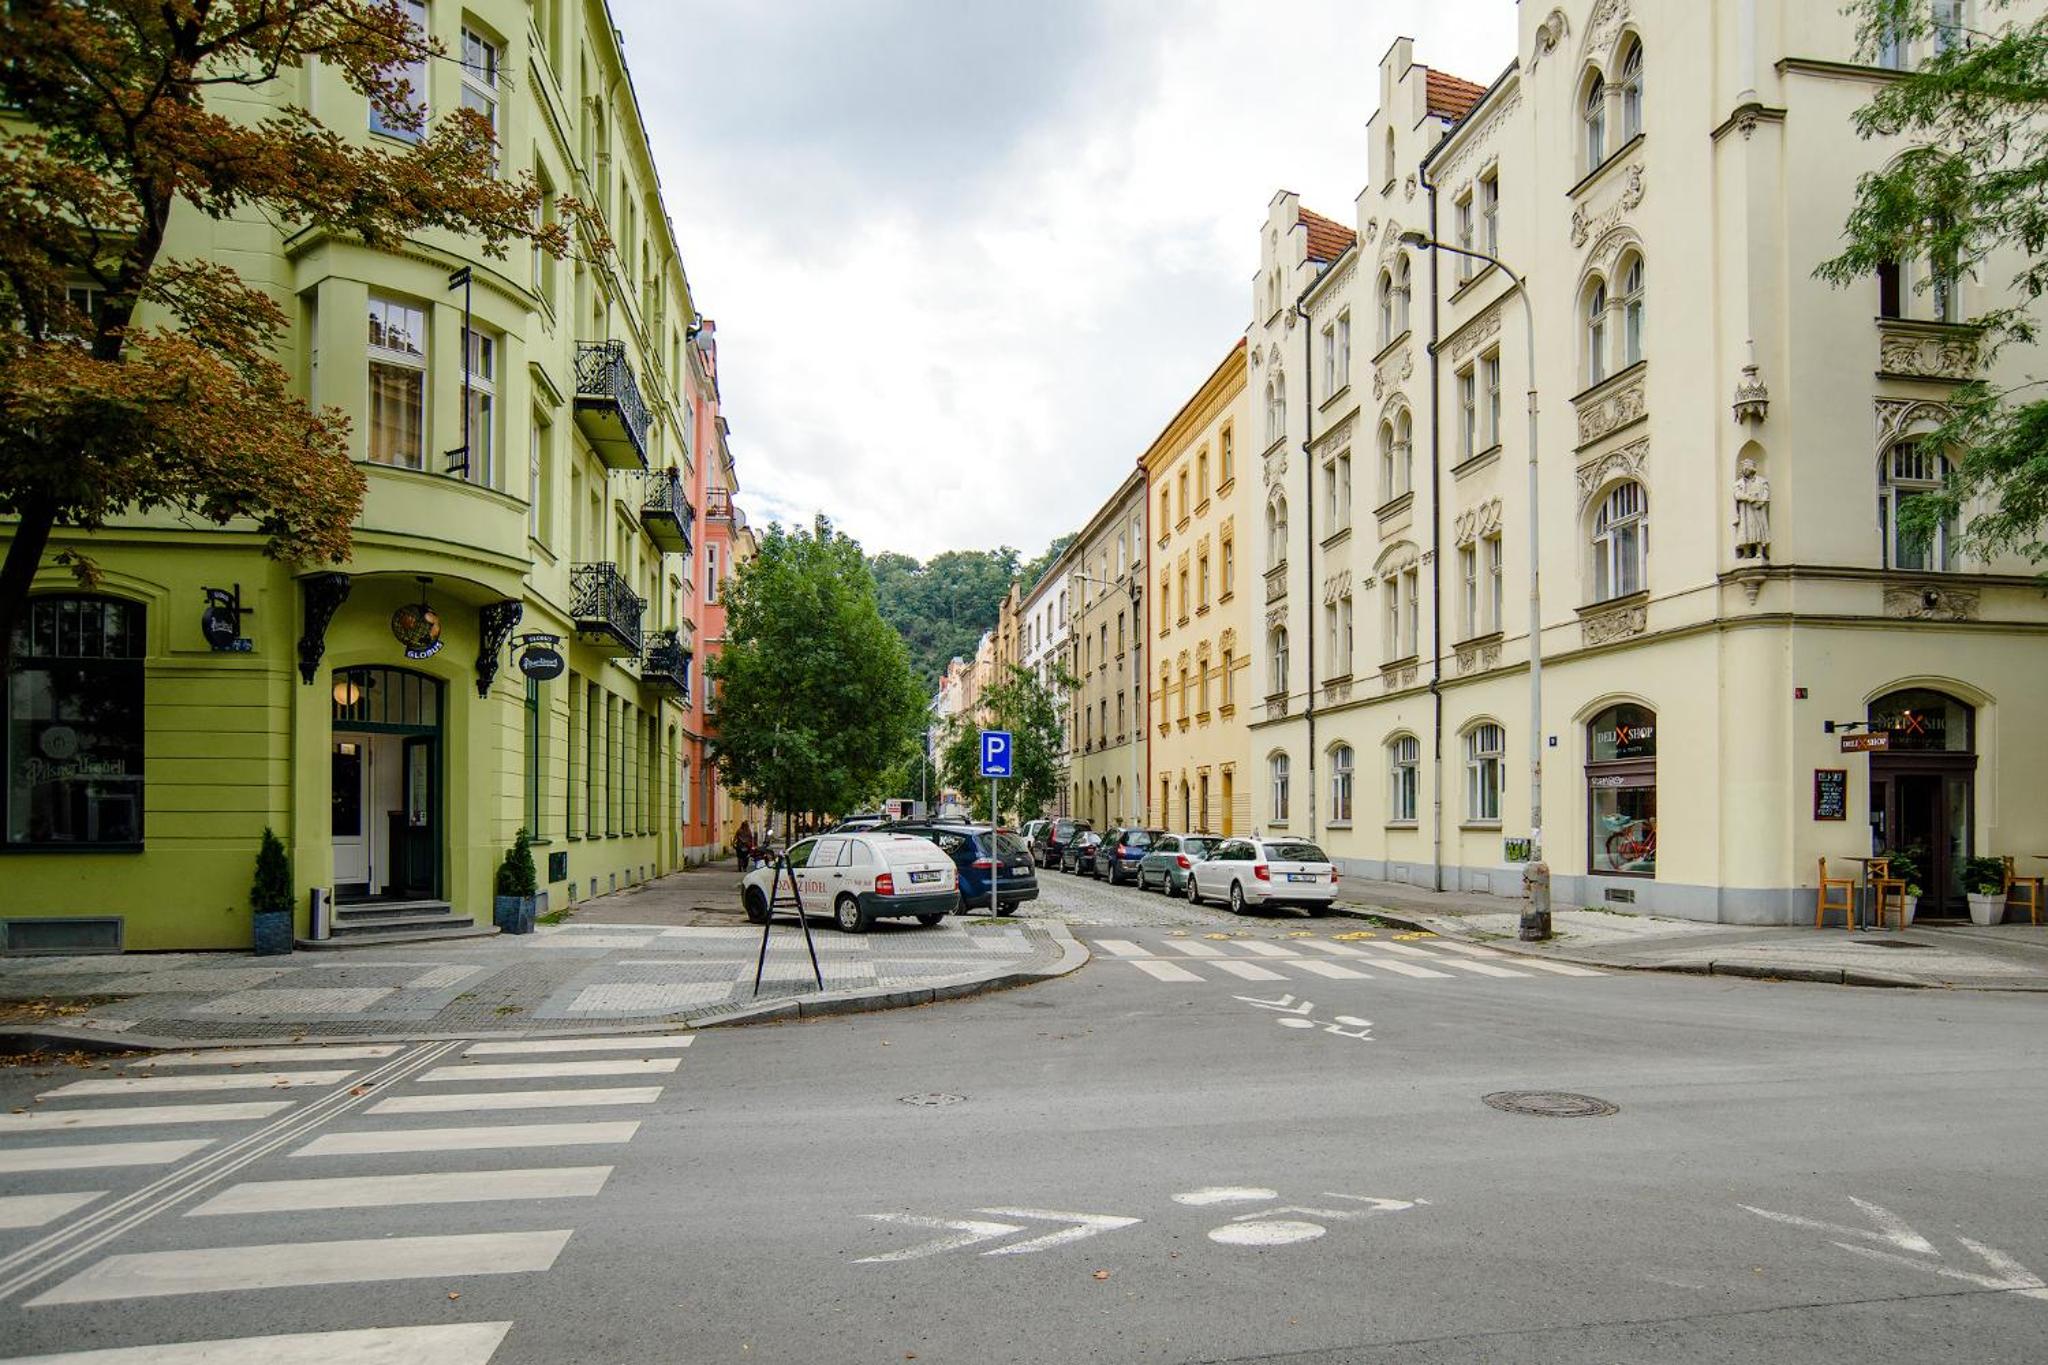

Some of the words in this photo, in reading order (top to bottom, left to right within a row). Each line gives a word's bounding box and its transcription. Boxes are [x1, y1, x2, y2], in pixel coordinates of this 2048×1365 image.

[407, 641, 443, 659] GLOBUS
[1597, 730, 1616, 743] DELI
[1628, 727, 1653, 740] SHOP
[1842, 739, 1858, 748] DELI
[1867, 737, 1886, 746] SHOP
[987, 736, 1006, 762] P
